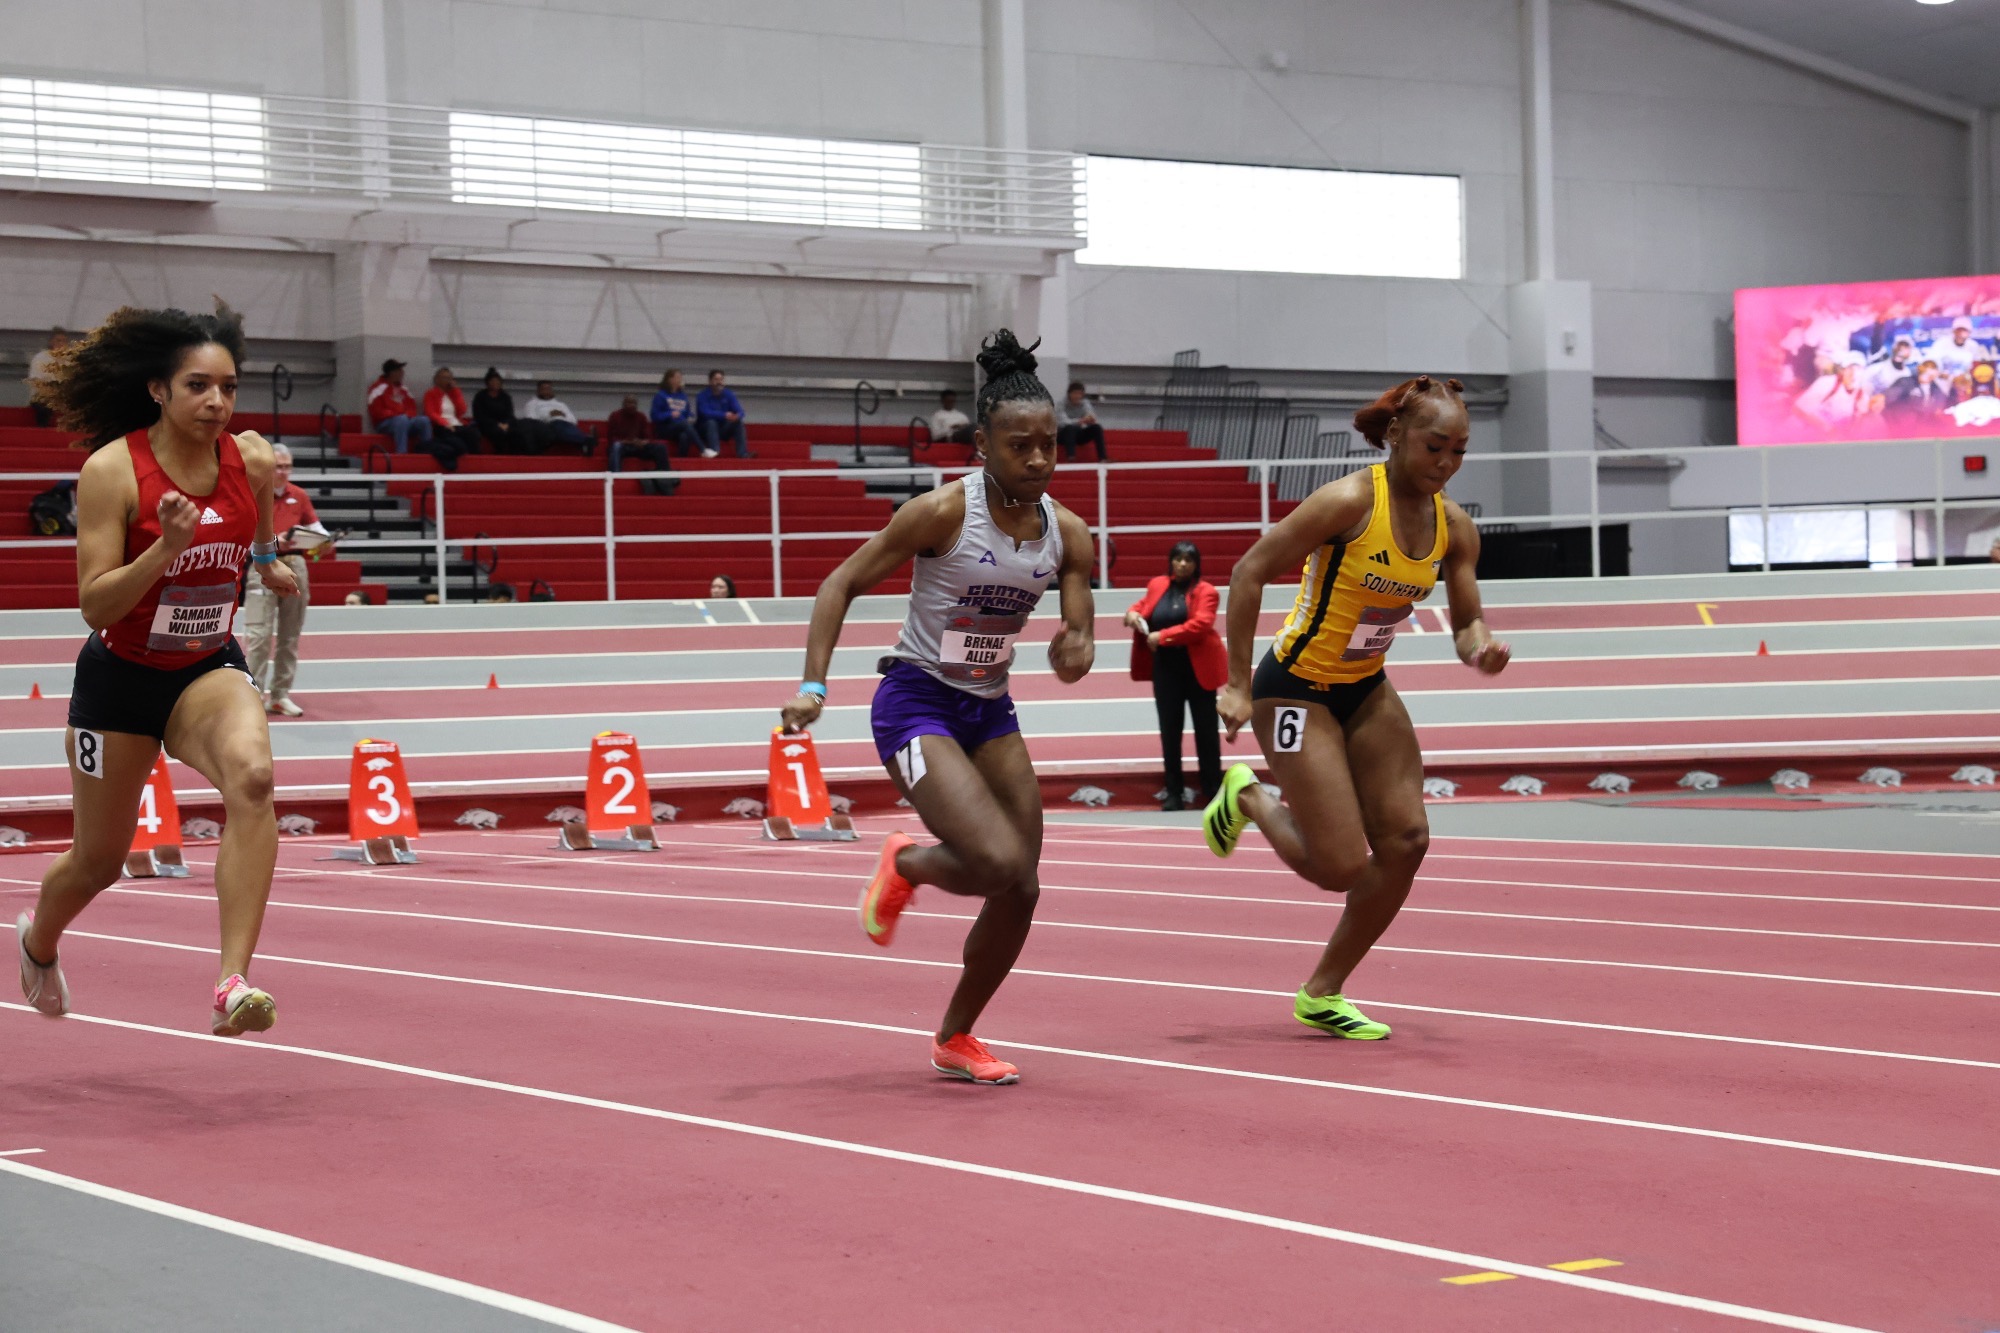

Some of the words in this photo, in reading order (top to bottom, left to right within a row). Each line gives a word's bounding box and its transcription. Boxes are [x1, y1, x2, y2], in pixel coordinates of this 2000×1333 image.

[1360, 572, 1422, 598] SOUTHERN
[168, 620, 220, 635] WILLIAMS
[172, 606, 223, 621] SAMARAH
[963, 635, 1006, 650] BRENAE
[964, 650, 998, 664] ALLEN
[1278, 709, 1299, 750] 6
[79, 731, 97, 773] 8
[366, 775, 401, 826] 3
[602, 766, 637, 815] 2
[786, 762, 811, 809] 1
[137, 783, 162, 834] 4
